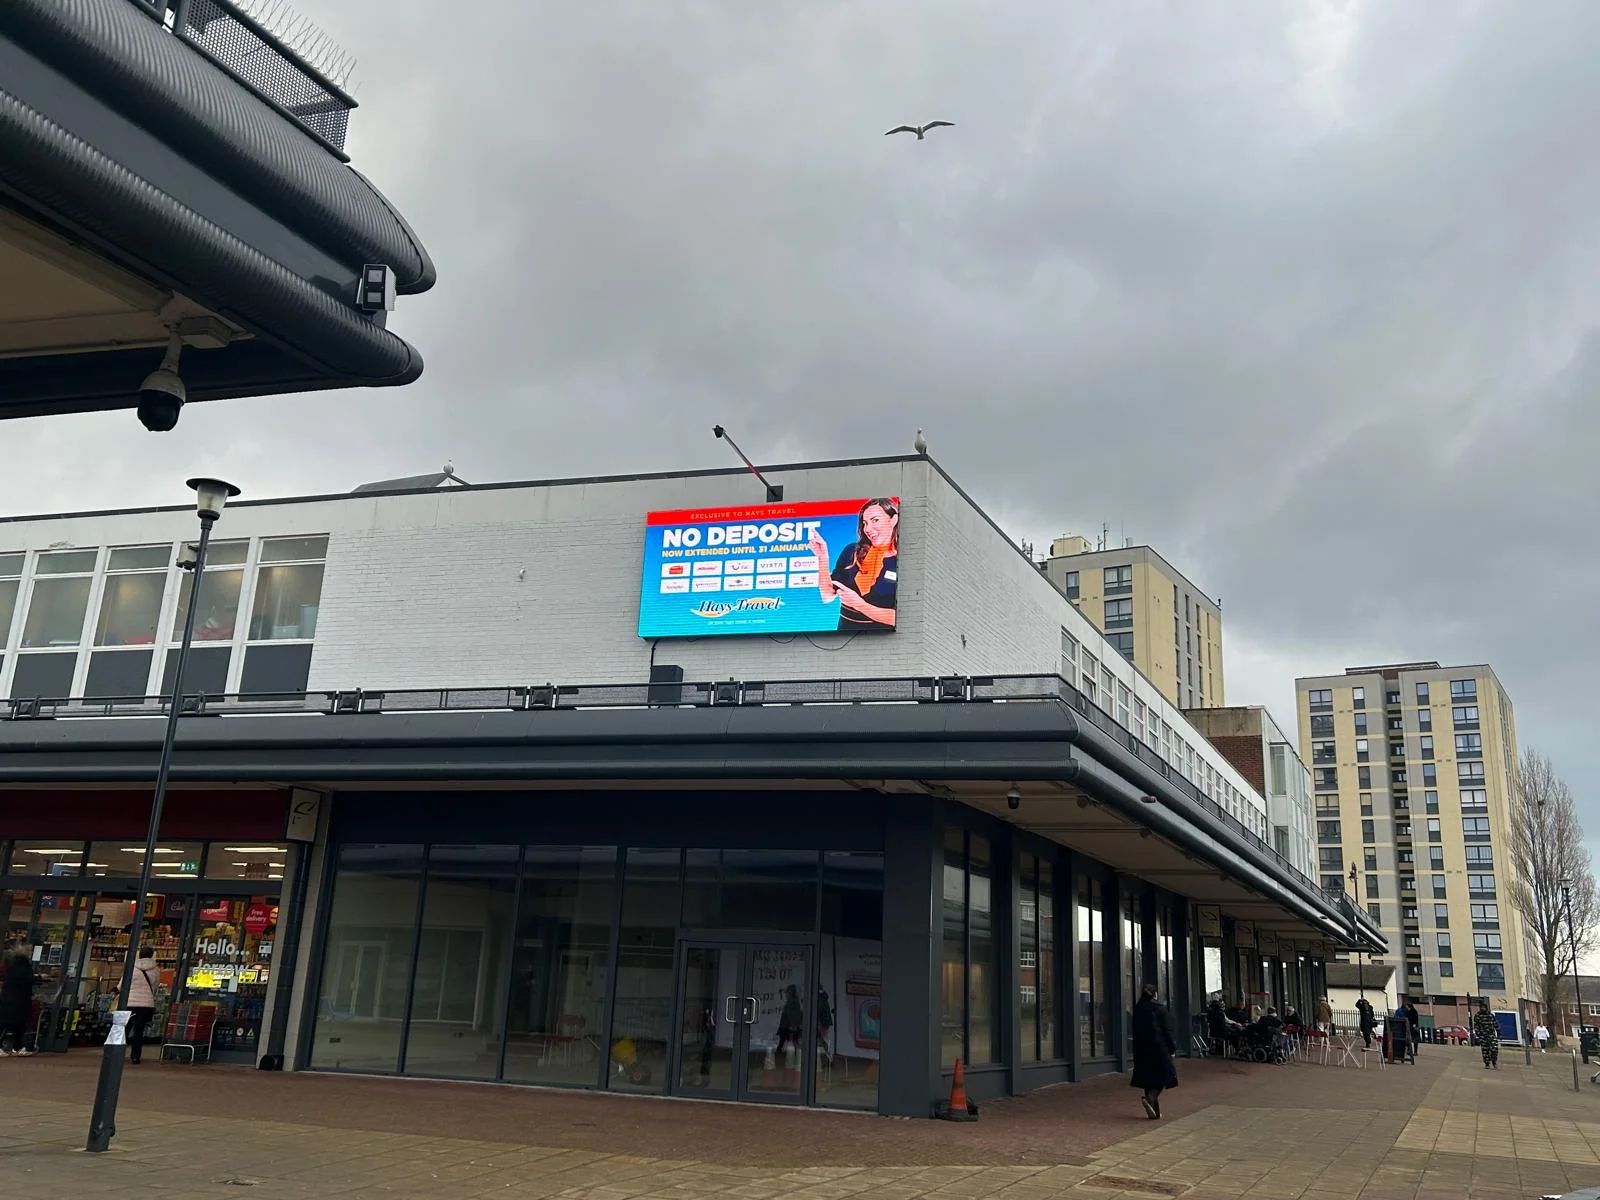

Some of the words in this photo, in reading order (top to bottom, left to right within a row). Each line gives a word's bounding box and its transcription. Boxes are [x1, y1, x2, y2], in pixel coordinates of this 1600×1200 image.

[690, 512, 730, 520] EXCLUSIVE
[663, 528, 701, 547] NO
[707, 521, 821, 545] DEPOSIT
[661, 550, 684, 558] NOW
[685, 548, 730, 556] EXTENDED
[731, 546, 756, 555] UNTIL
[758, 545, 767, 553] 31
[699, 601, 733, 615] Hays
[736, 597, 781, 611] Travel
[246, 914, 267, 923] delivery
[251, 908, 264, 916] Free
[195, 938, 250, 956] Hello...
